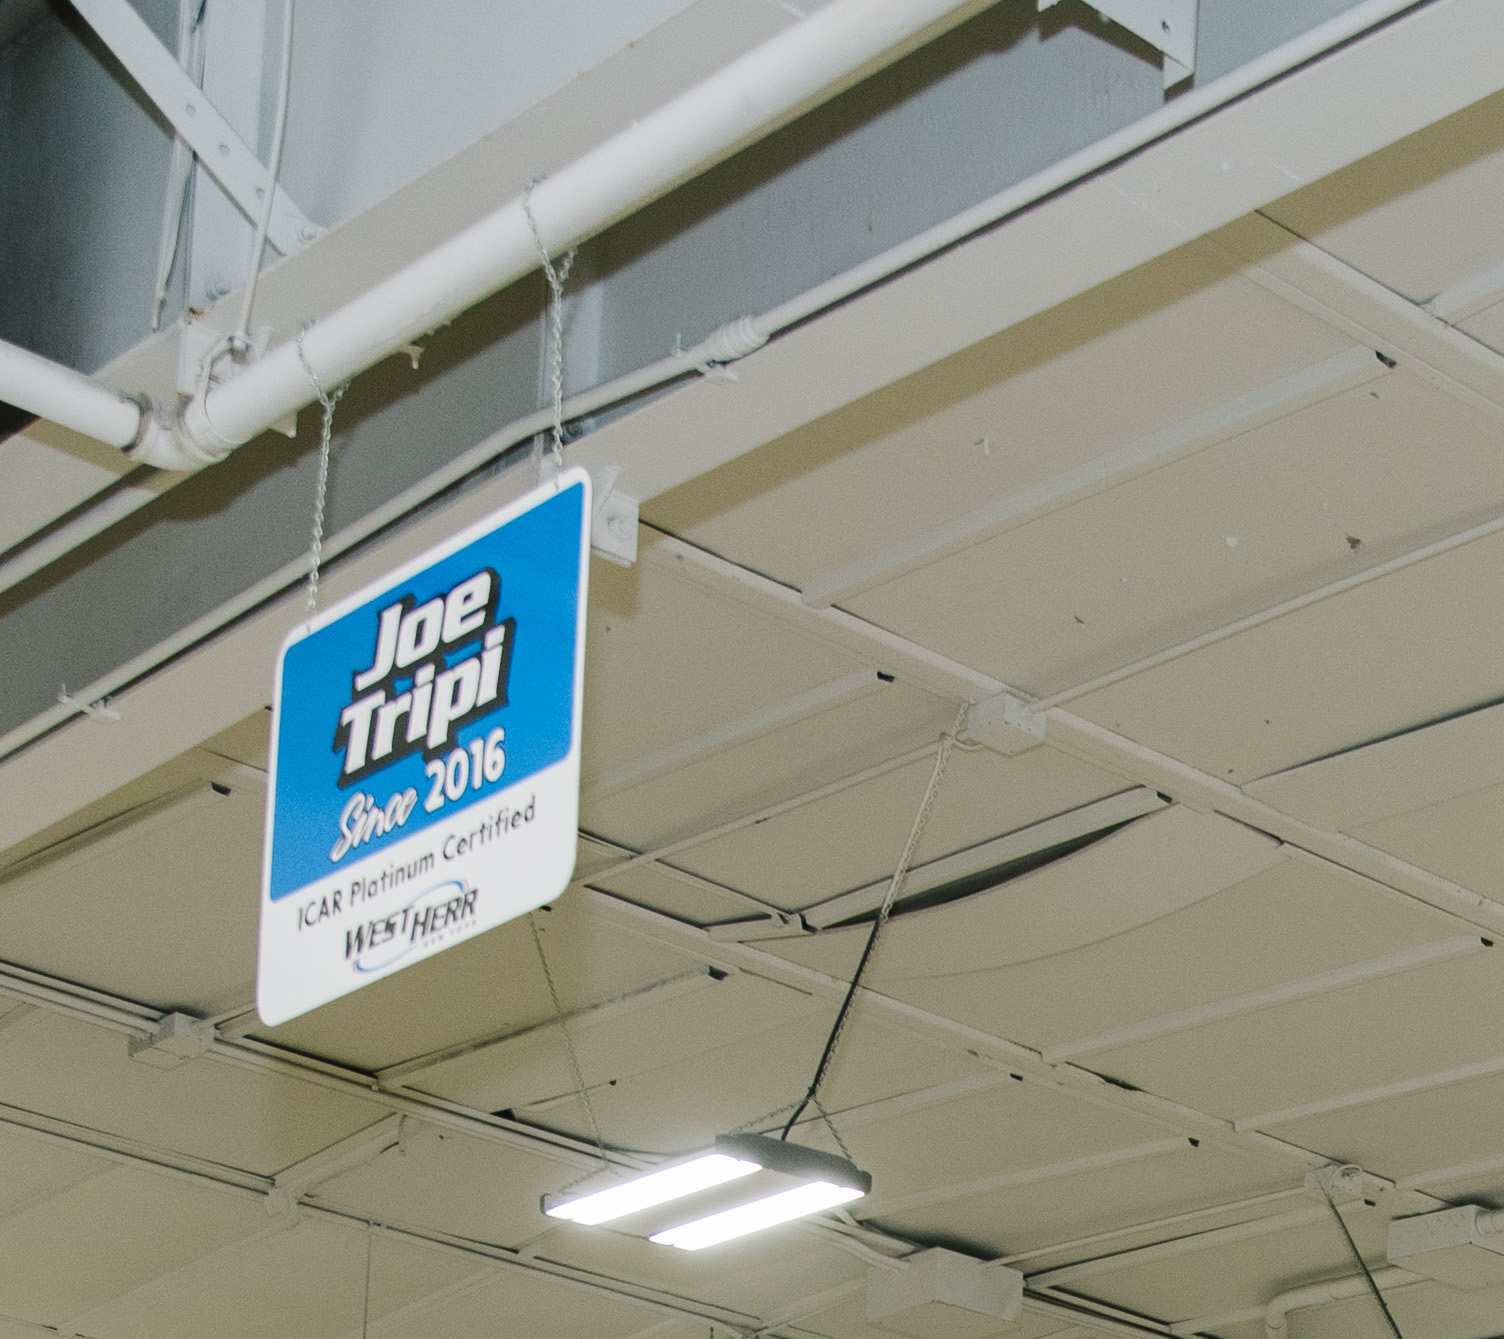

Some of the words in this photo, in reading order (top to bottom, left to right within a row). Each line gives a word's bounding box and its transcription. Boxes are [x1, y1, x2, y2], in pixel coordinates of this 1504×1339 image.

[355, 568, 493, 692] Joe
[340, 624, 506, 776] Tripi
[330, 787, 419, 863] Since
[425, 726, 507, 813] 2016
[297, 889, 344, 932] ICAR
[350, 849, 435, 903] Platinum
[441, 795, 537, 864] Certified
